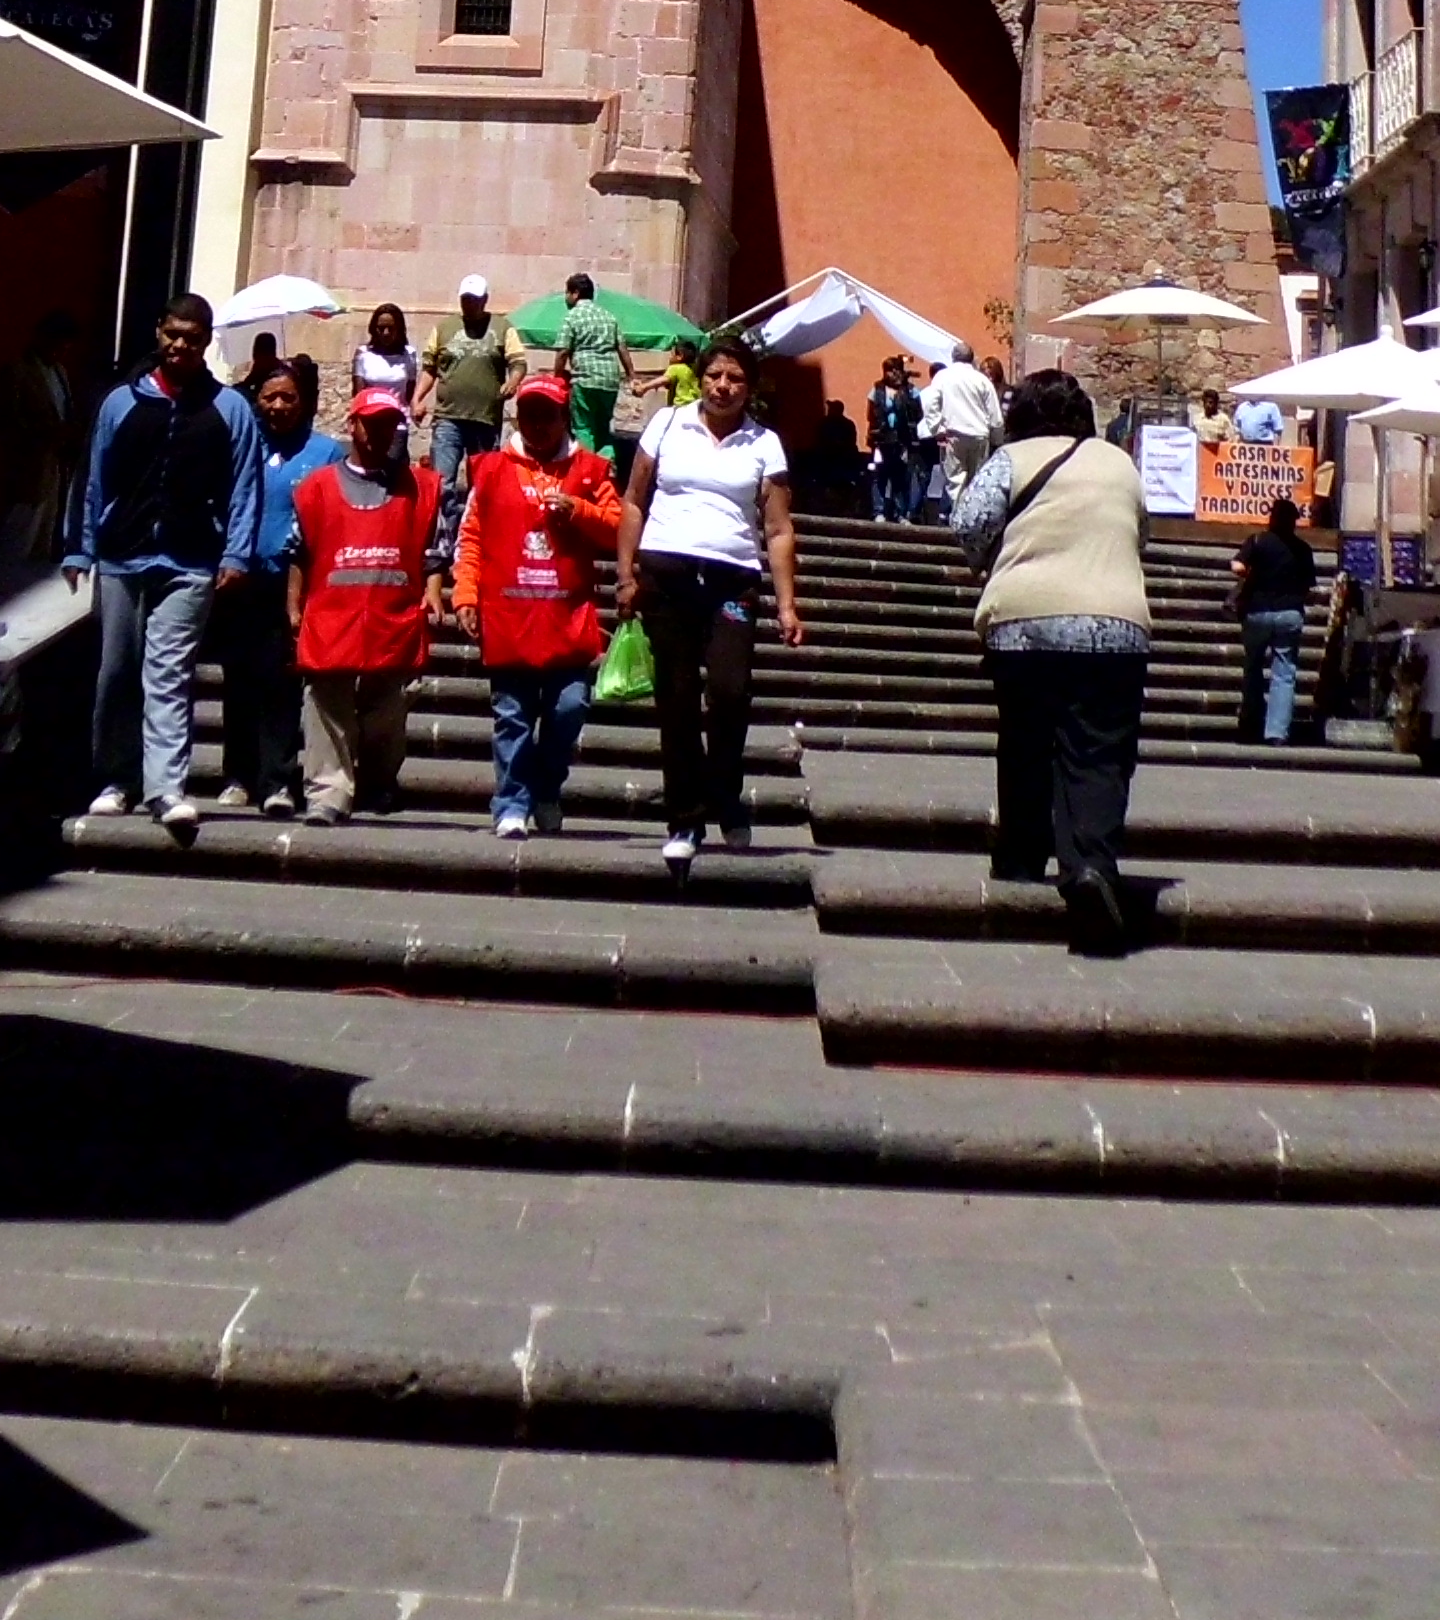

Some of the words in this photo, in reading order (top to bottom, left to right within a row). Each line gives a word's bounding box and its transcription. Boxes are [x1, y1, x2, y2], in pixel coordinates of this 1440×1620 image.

[1229, 445, 1266, 462] CASA
[1272, 448, 1291, 464] DE
[1214, 463, 1305, 483] ARTESANIAS
[1226, 482, 1235, 495] Y
[1241, 481, 1293, 499] DULCES
